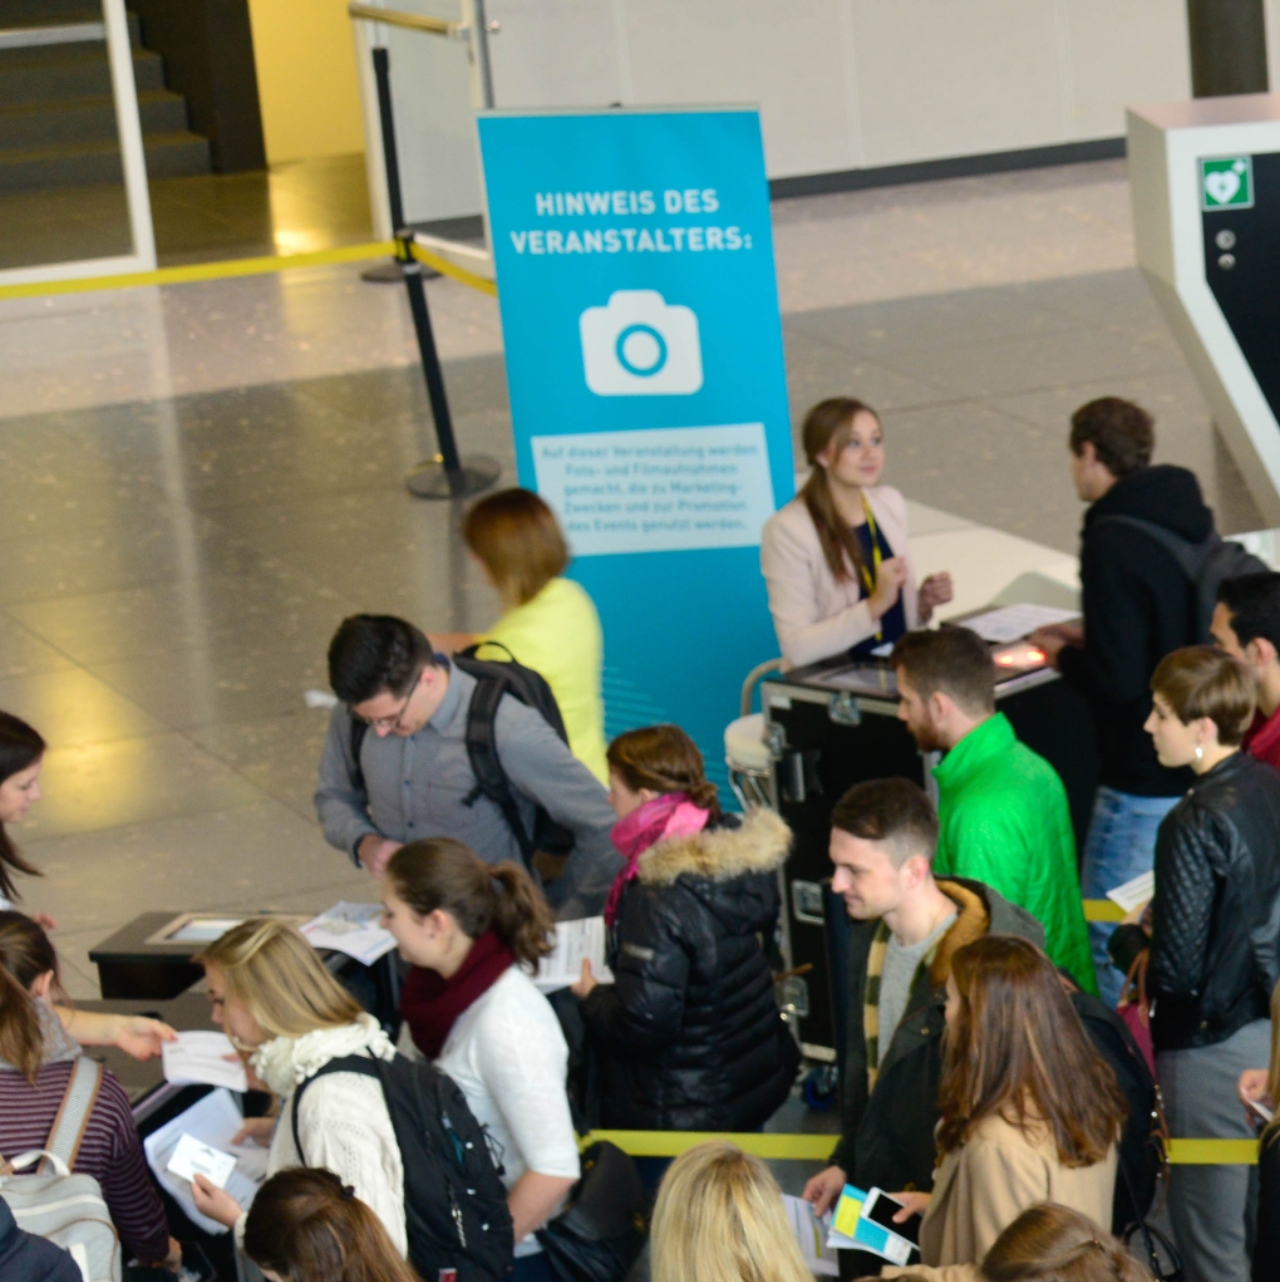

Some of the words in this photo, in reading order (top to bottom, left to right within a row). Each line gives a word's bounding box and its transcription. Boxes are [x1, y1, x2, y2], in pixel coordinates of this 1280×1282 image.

[535, 190, 656, 216] HINWEIS
[664, 188, 719, 214] DES
[510, 226, 753, 255] VERANSTALTERS:
[612, 443, 706, 459] Veranstaltung
[708, 443, 758, 455] werden
